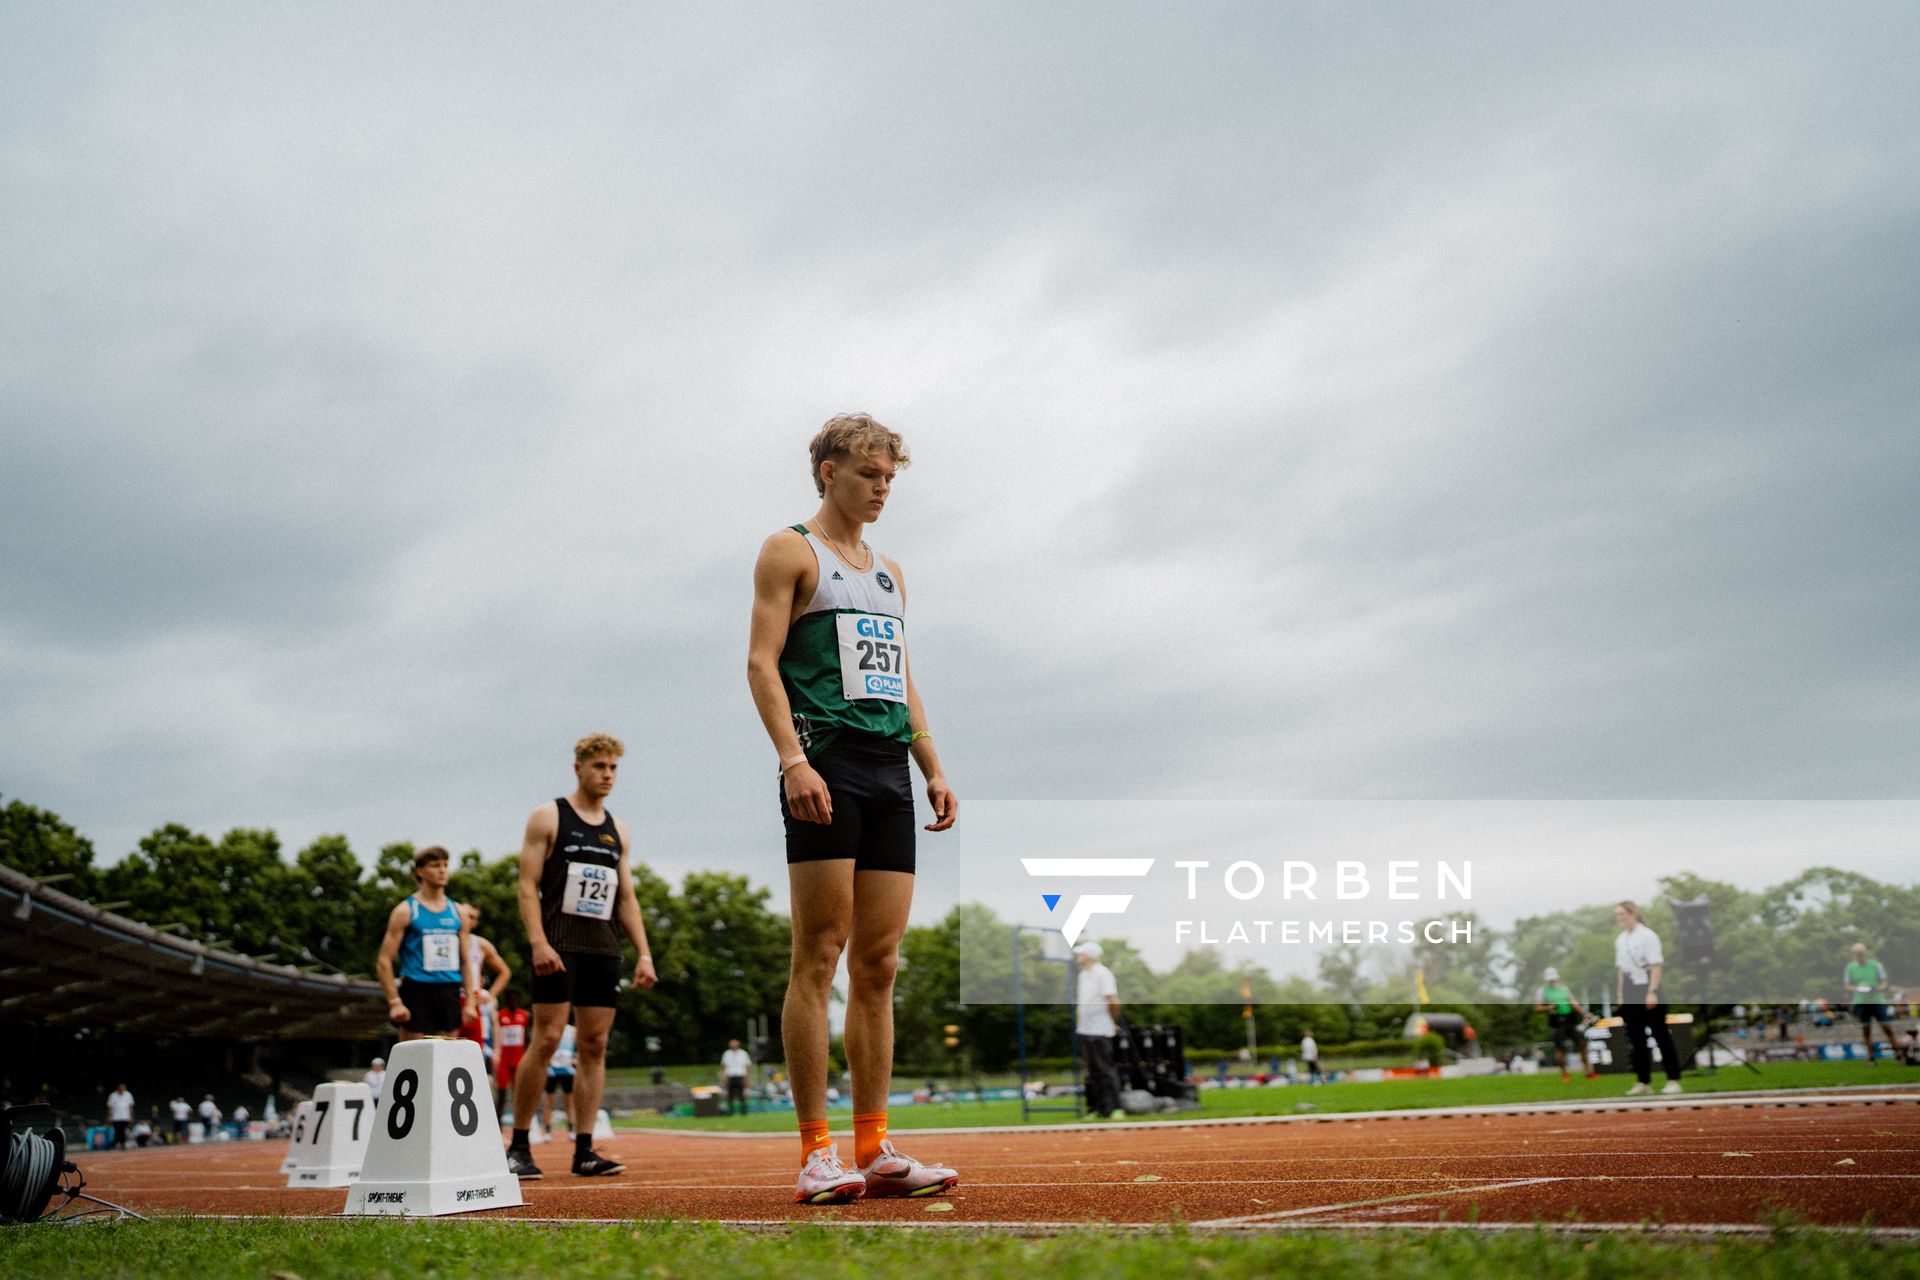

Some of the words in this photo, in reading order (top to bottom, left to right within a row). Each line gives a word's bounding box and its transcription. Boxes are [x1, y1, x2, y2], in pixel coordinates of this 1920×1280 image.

[856, 640, 902, 674] 257
[578, 879, 609, 901] 124
[583, 867, 608, 881] GLS
[311, 1101, 329, 1145] 7
[344, 1099, 364, 1141] 7
[387, 1068, 419, 1140] 8
[447, 1067, 479, 1137] 8
